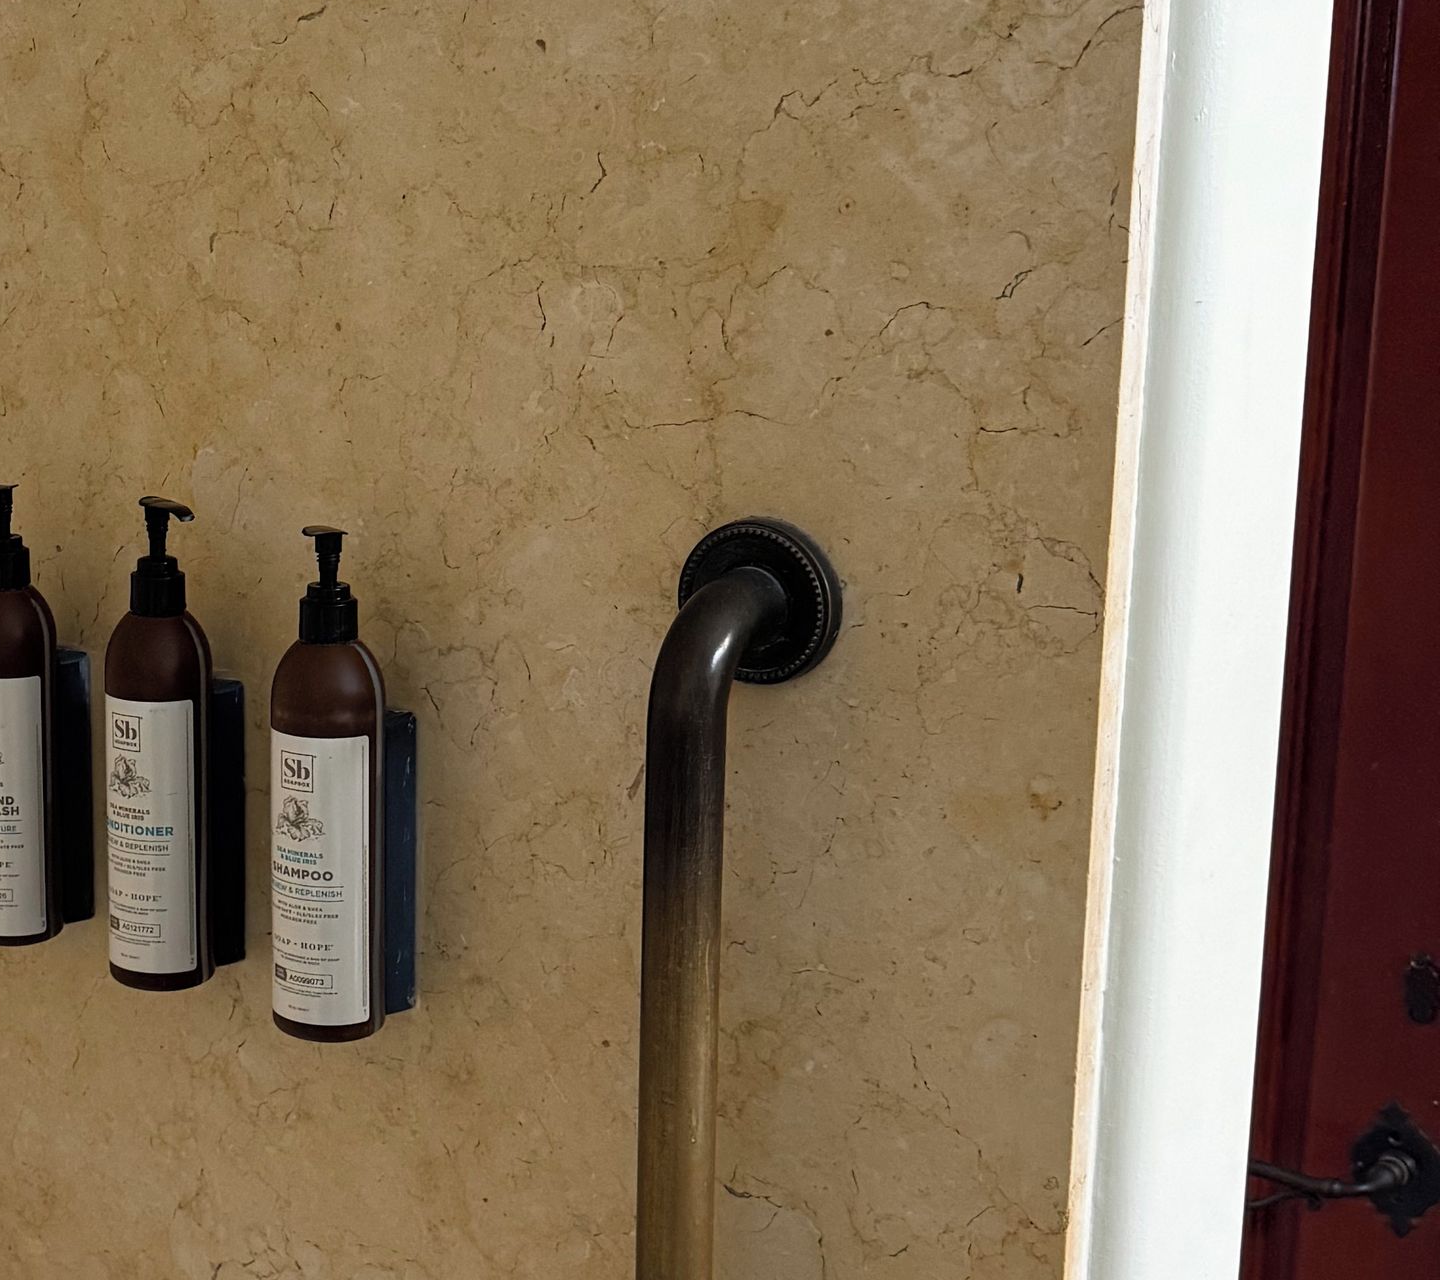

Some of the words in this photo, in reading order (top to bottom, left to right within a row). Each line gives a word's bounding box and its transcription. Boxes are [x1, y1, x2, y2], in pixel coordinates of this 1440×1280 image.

[115, 719, 137, 740] Sb
[284, 758, 310, 780] Sb
[119, 806, 150, 815] MINERALS
[107, 819, 174, 836] NDITIONER
[125, 842, 169, 852] REPLENISH
[287, 848, 323, 859] MINERALS
[285, 855, 300, 864] BLUE
[273, 861, 333, 881] SHAMPOO
[295, 887, 342, 898] REPLENISH
